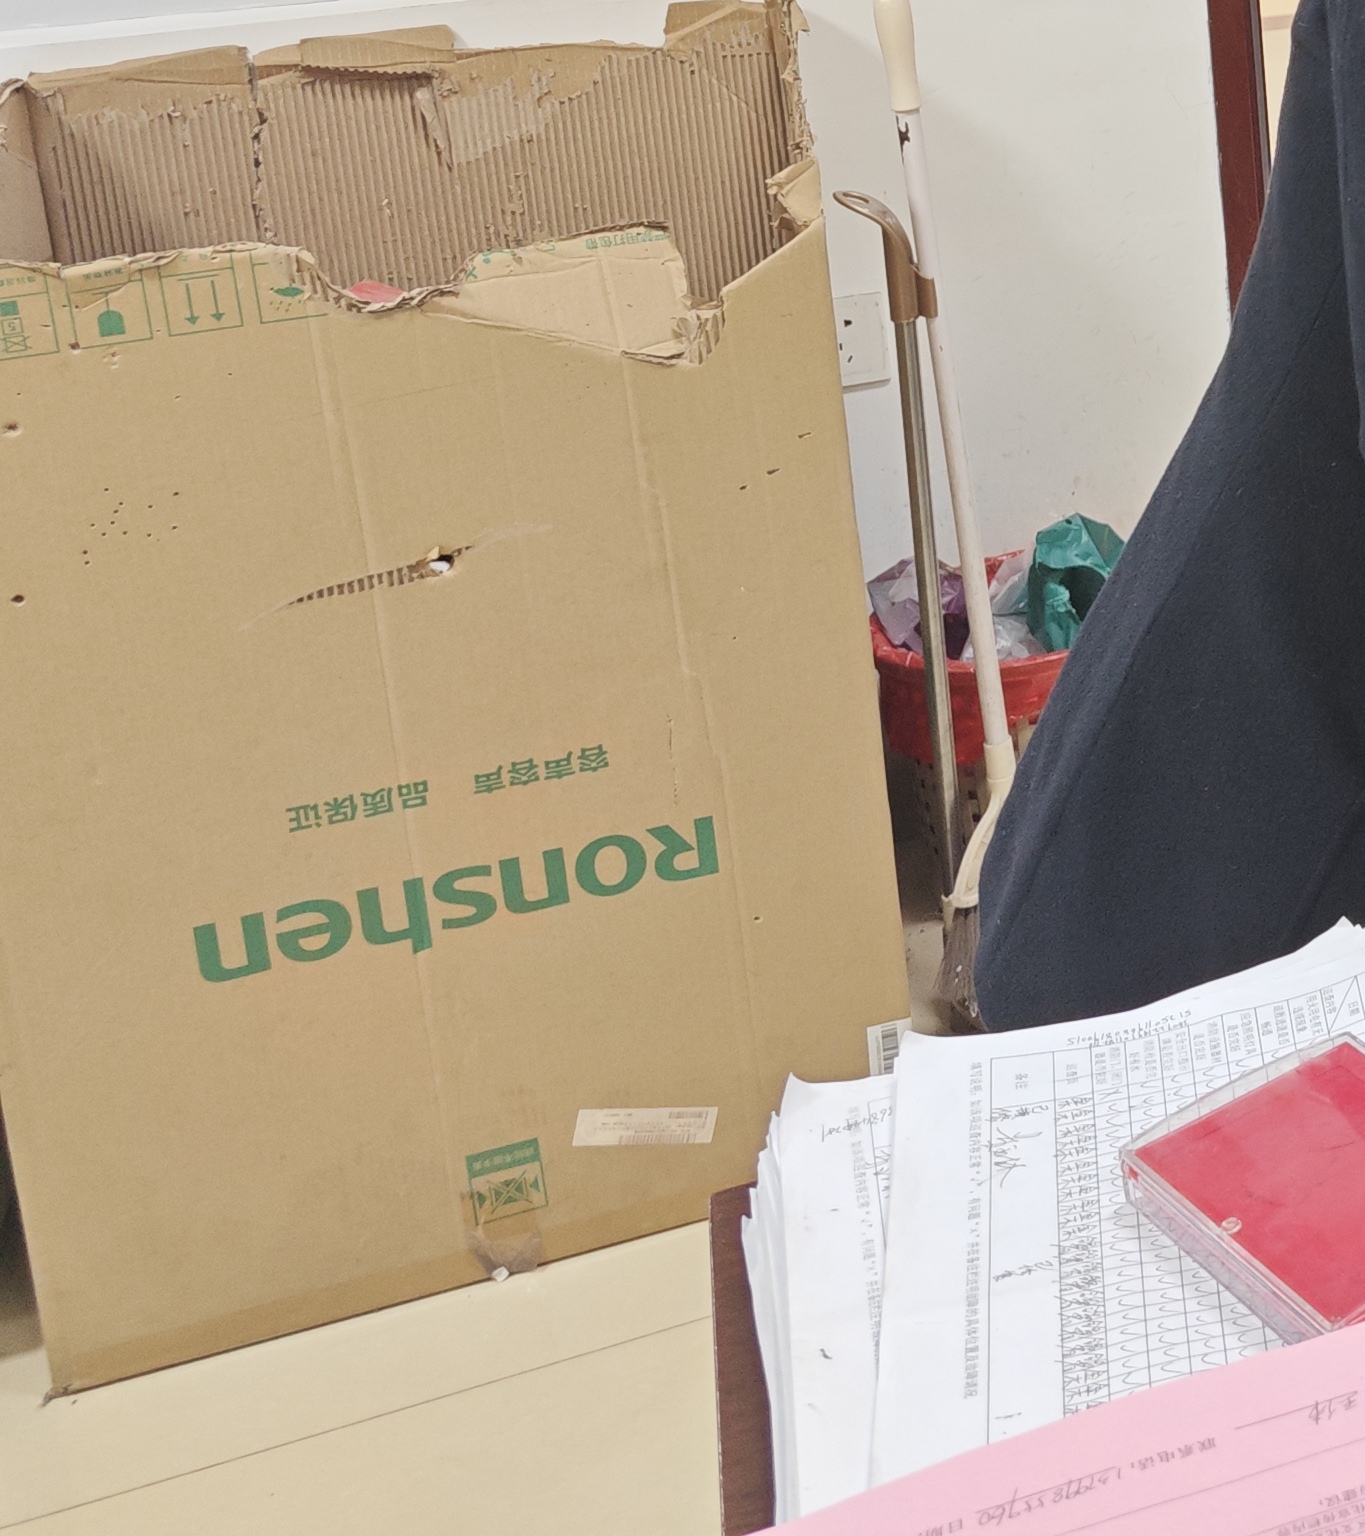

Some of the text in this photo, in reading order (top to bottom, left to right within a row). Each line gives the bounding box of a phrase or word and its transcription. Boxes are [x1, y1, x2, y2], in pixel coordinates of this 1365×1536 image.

[285, 744, 610, 833] 容声容声 品质保证
[193, 815, 720, 983] Ronshen
